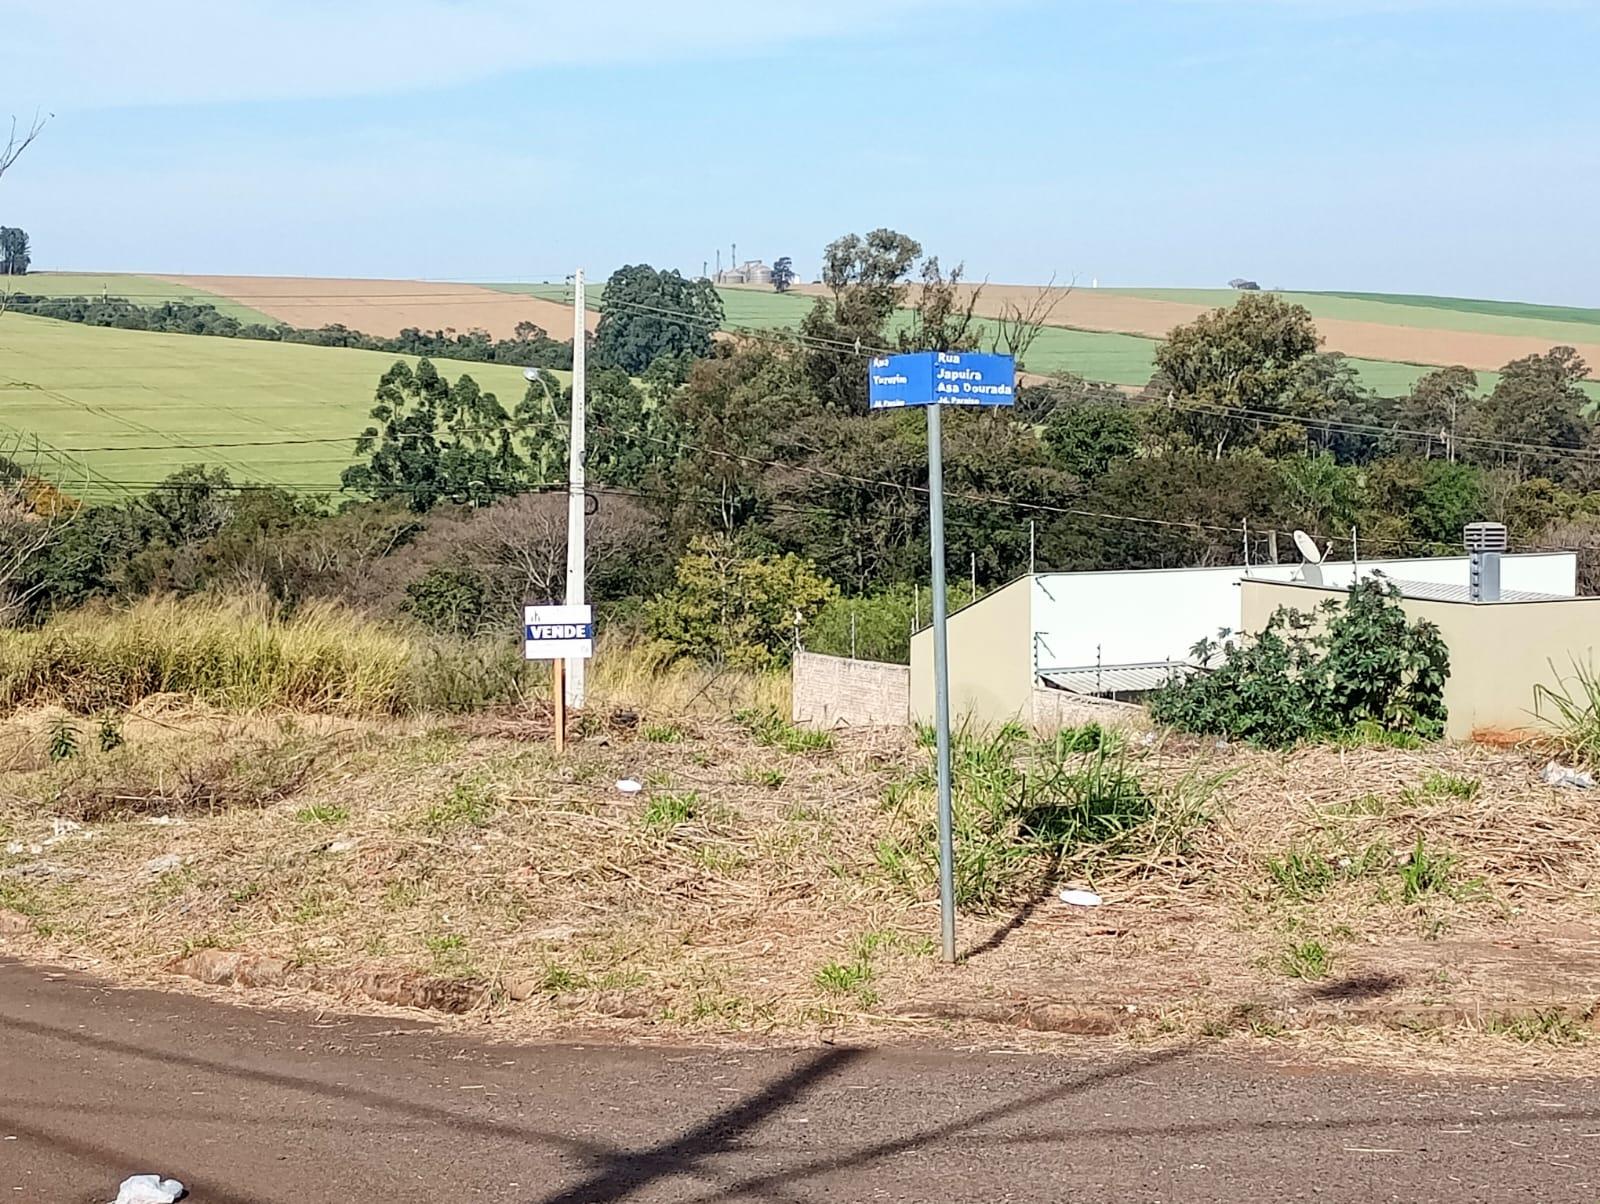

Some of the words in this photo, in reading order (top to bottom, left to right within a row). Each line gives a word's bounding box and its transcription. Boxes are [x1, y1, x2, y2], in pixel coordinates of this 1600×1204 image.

[938, 352, 960, 364] Rua
[937, 368, 982, 381] Japuira
[938, 382, 960, 393] Asa
[963, 382, 1012, 395] Dourada
[530, 625, 586, 639] VENDE
